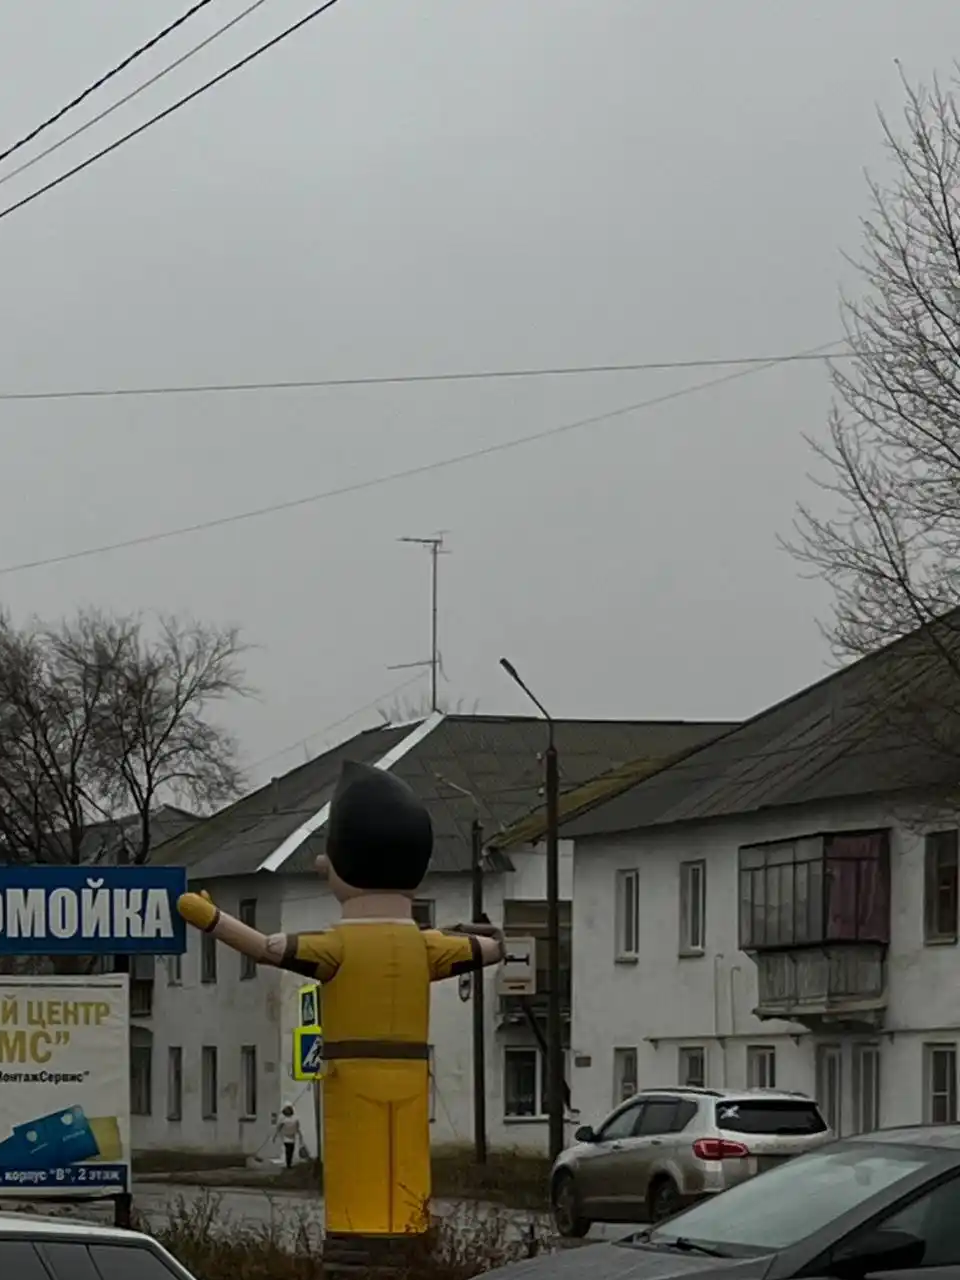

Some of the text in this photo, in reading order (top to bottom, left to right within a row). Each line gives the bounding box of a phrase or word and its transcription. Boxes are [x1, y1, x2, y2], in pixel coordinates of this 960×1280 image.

[26, 1000, 110, 1029] ЦЕНТР
[4, 1170, 47, 1183] корпус
[78, 1168, 86, 1181] 2
[88, 1170, 121, 1181] этаж
